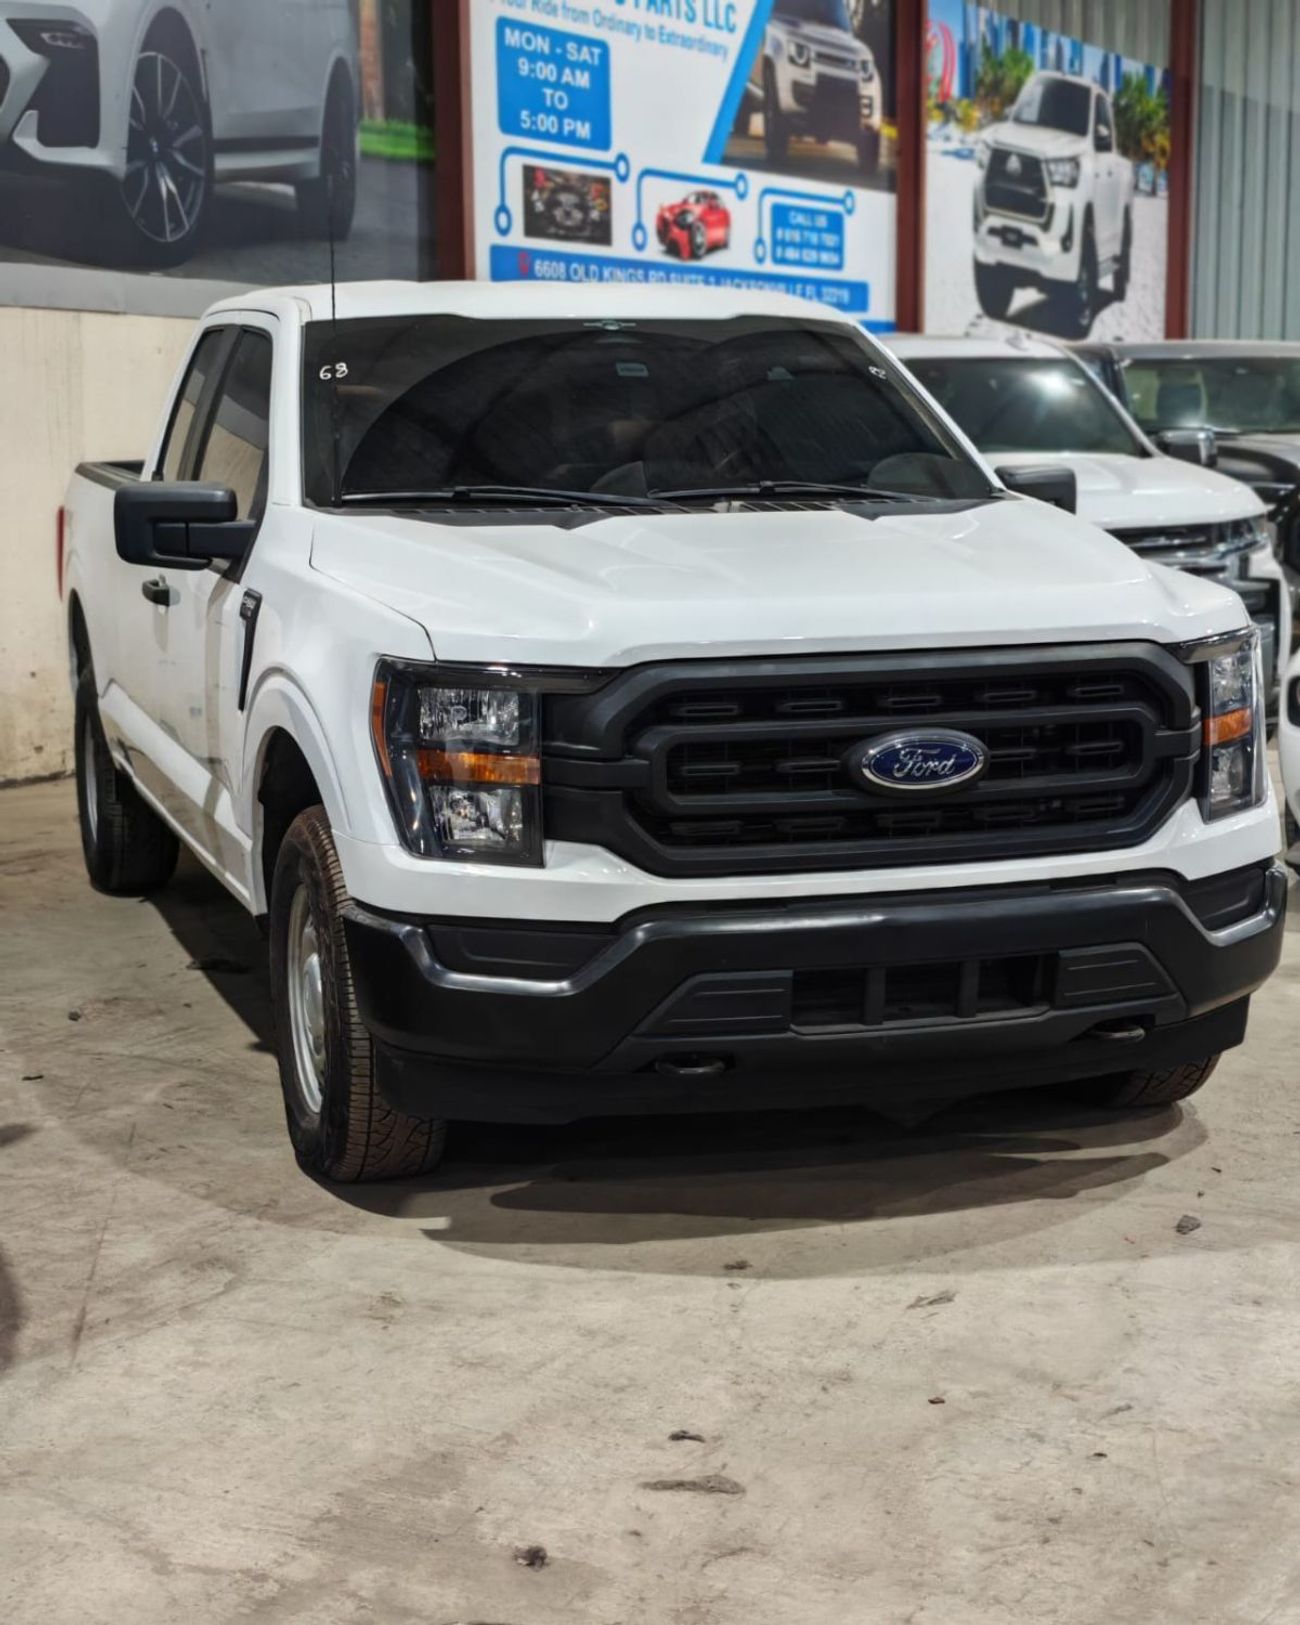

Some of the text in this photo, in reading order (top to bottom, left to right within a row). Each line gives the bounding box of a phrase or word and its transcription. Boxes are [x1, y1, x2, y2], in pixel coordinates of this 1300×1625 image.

[561, 0, 589, 24] from
[592, 8, 641, 42] Ordinary
[644, 24, 656, 41] to
[658, 25, 728, 62] Extraordinary
[703, 0, 737, 34] LLC
[504, 26, 550, 55] MON
[566, 41, 602, 66] SAT
[517, 57, 590, 89] 9:00 AM
[541, 87, 568, 110] TO
[520, 109, 591, 140] 5:00 PM
[533, 259, 566, 279] 6608
[569, 263, 599, 283] OLD
[319, 362, 349, 380] 68
[893, 748, 958, 778] Ford
